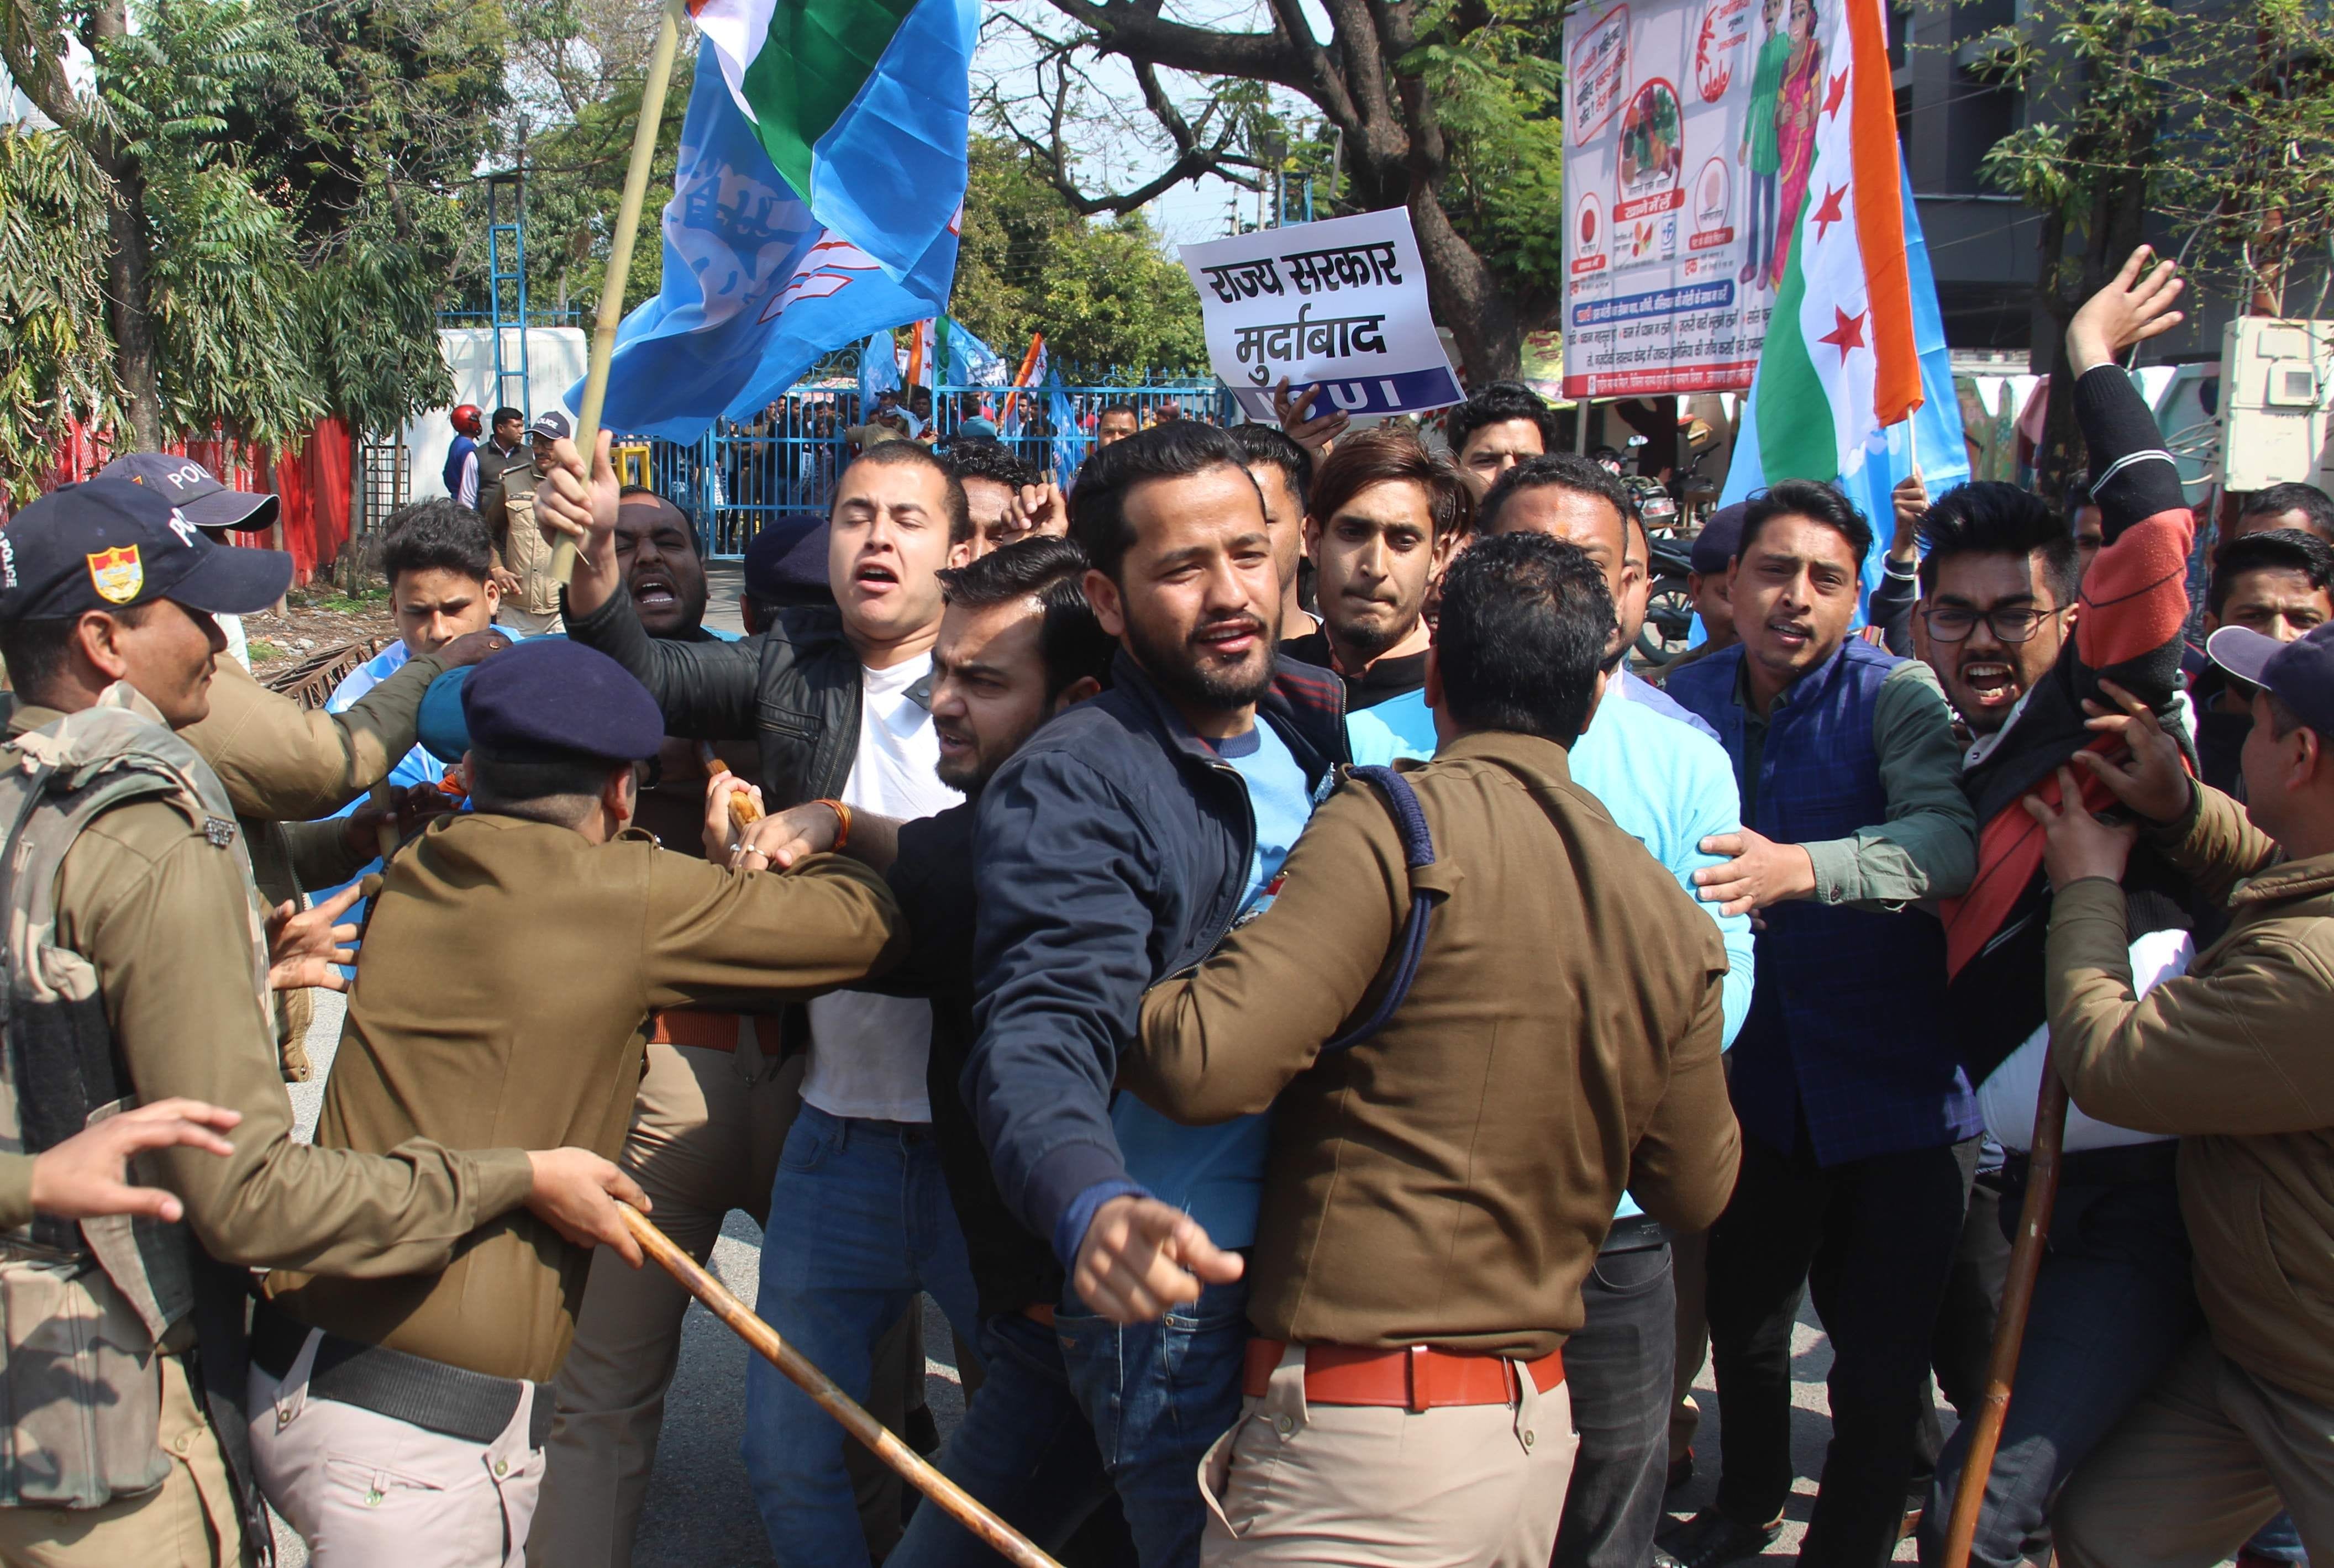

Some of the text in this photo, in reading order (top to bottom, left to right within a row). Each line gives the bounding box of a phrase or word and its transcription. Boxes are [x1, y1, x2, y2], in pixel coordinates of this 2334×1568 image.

[1624, 197, 1648, 218] खाने
[1200, 241, 1403, 303] राज्य सरकार
[1234, 302, 1387, 387] मुर्दाबाद
[538, 417, 558, 429] OLICE
[167, 462, 212, 490] POLI
